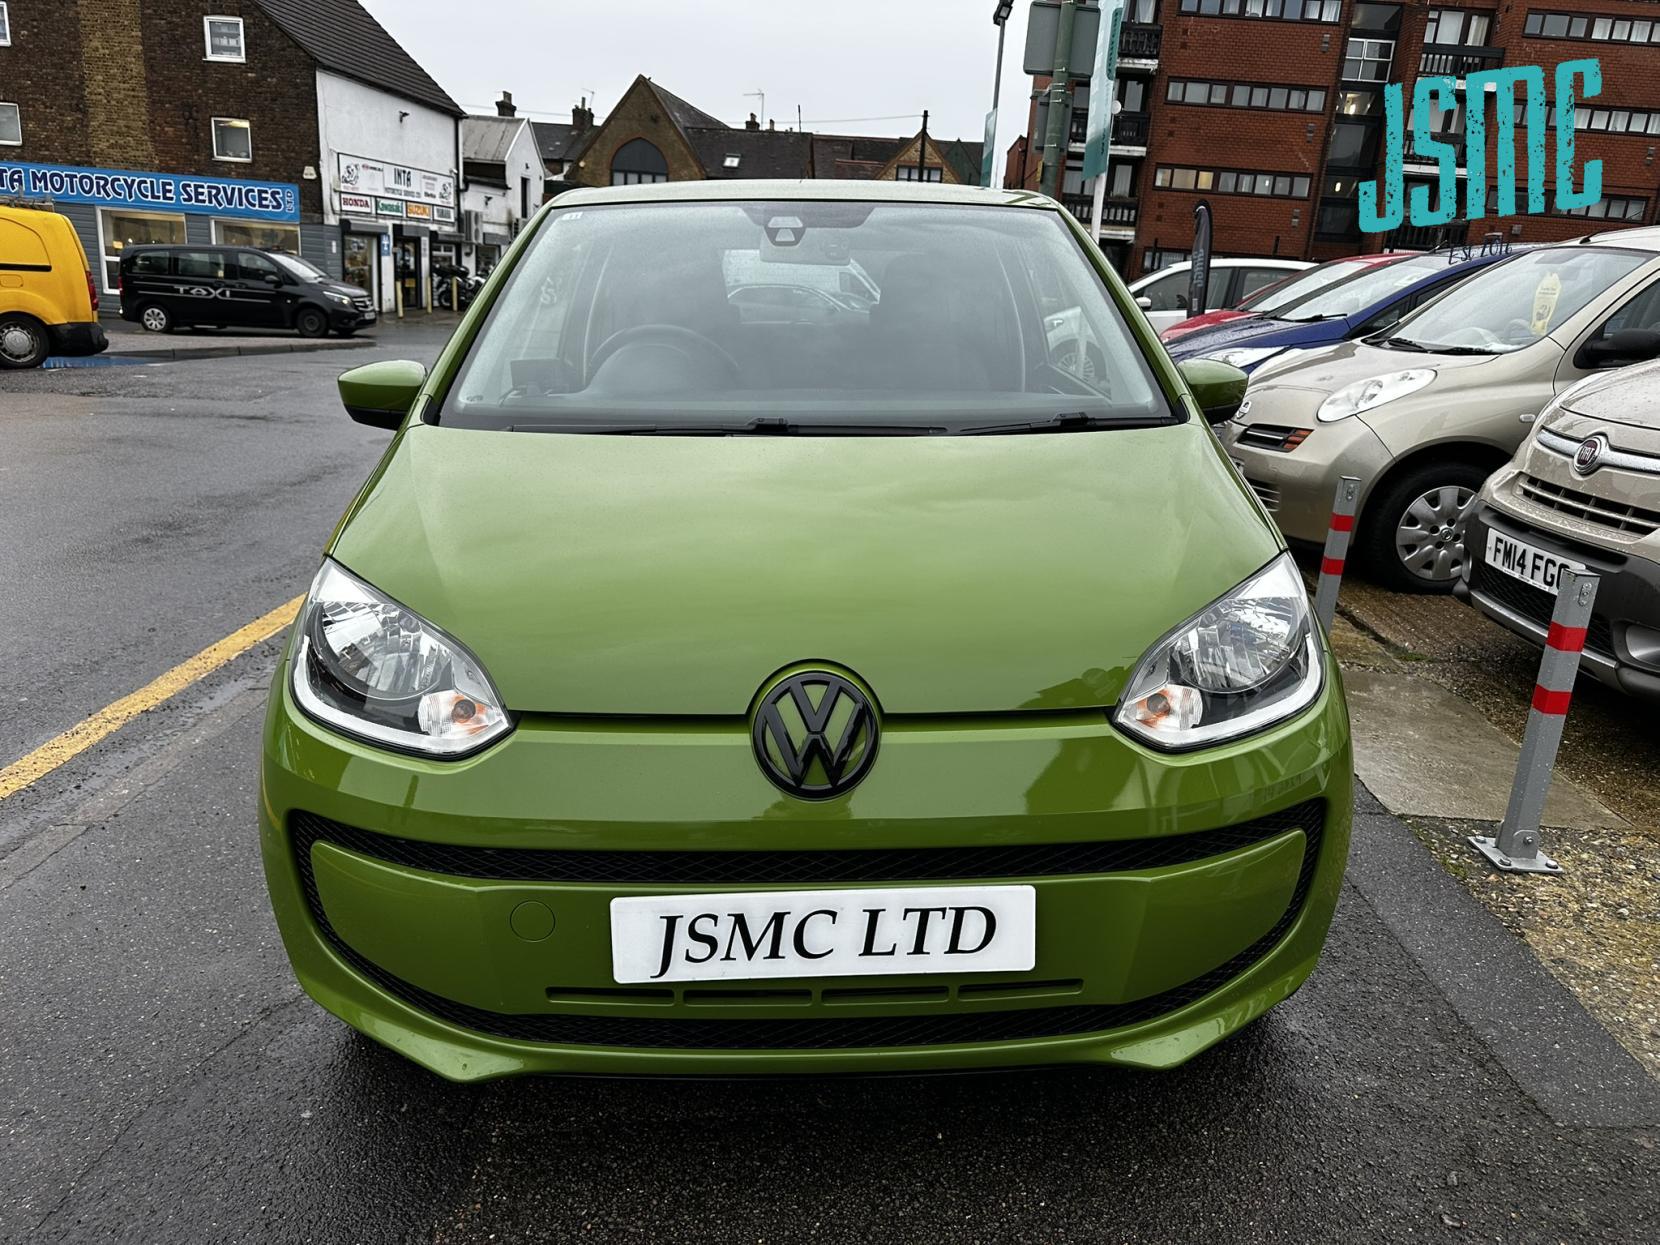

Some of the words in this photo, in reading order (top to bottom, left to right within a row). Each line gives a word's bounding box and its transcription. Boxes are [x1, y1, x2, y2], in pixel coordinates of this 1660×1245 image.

[393, 167, 412, 188] INTA
[30, 169, 175, 203] MOTORCYCLE
[181, 182, 284, 213] SERVICES
[285, 189, 295, 213] LTD
[342, 197, 370, 208] HONDA
[174, 285, 231, 299] TAXI
[1493, 536, 1527, 576] FM14
[650, 909, 837, 979] JSMC
[858, 906, 997, 957] LTD
